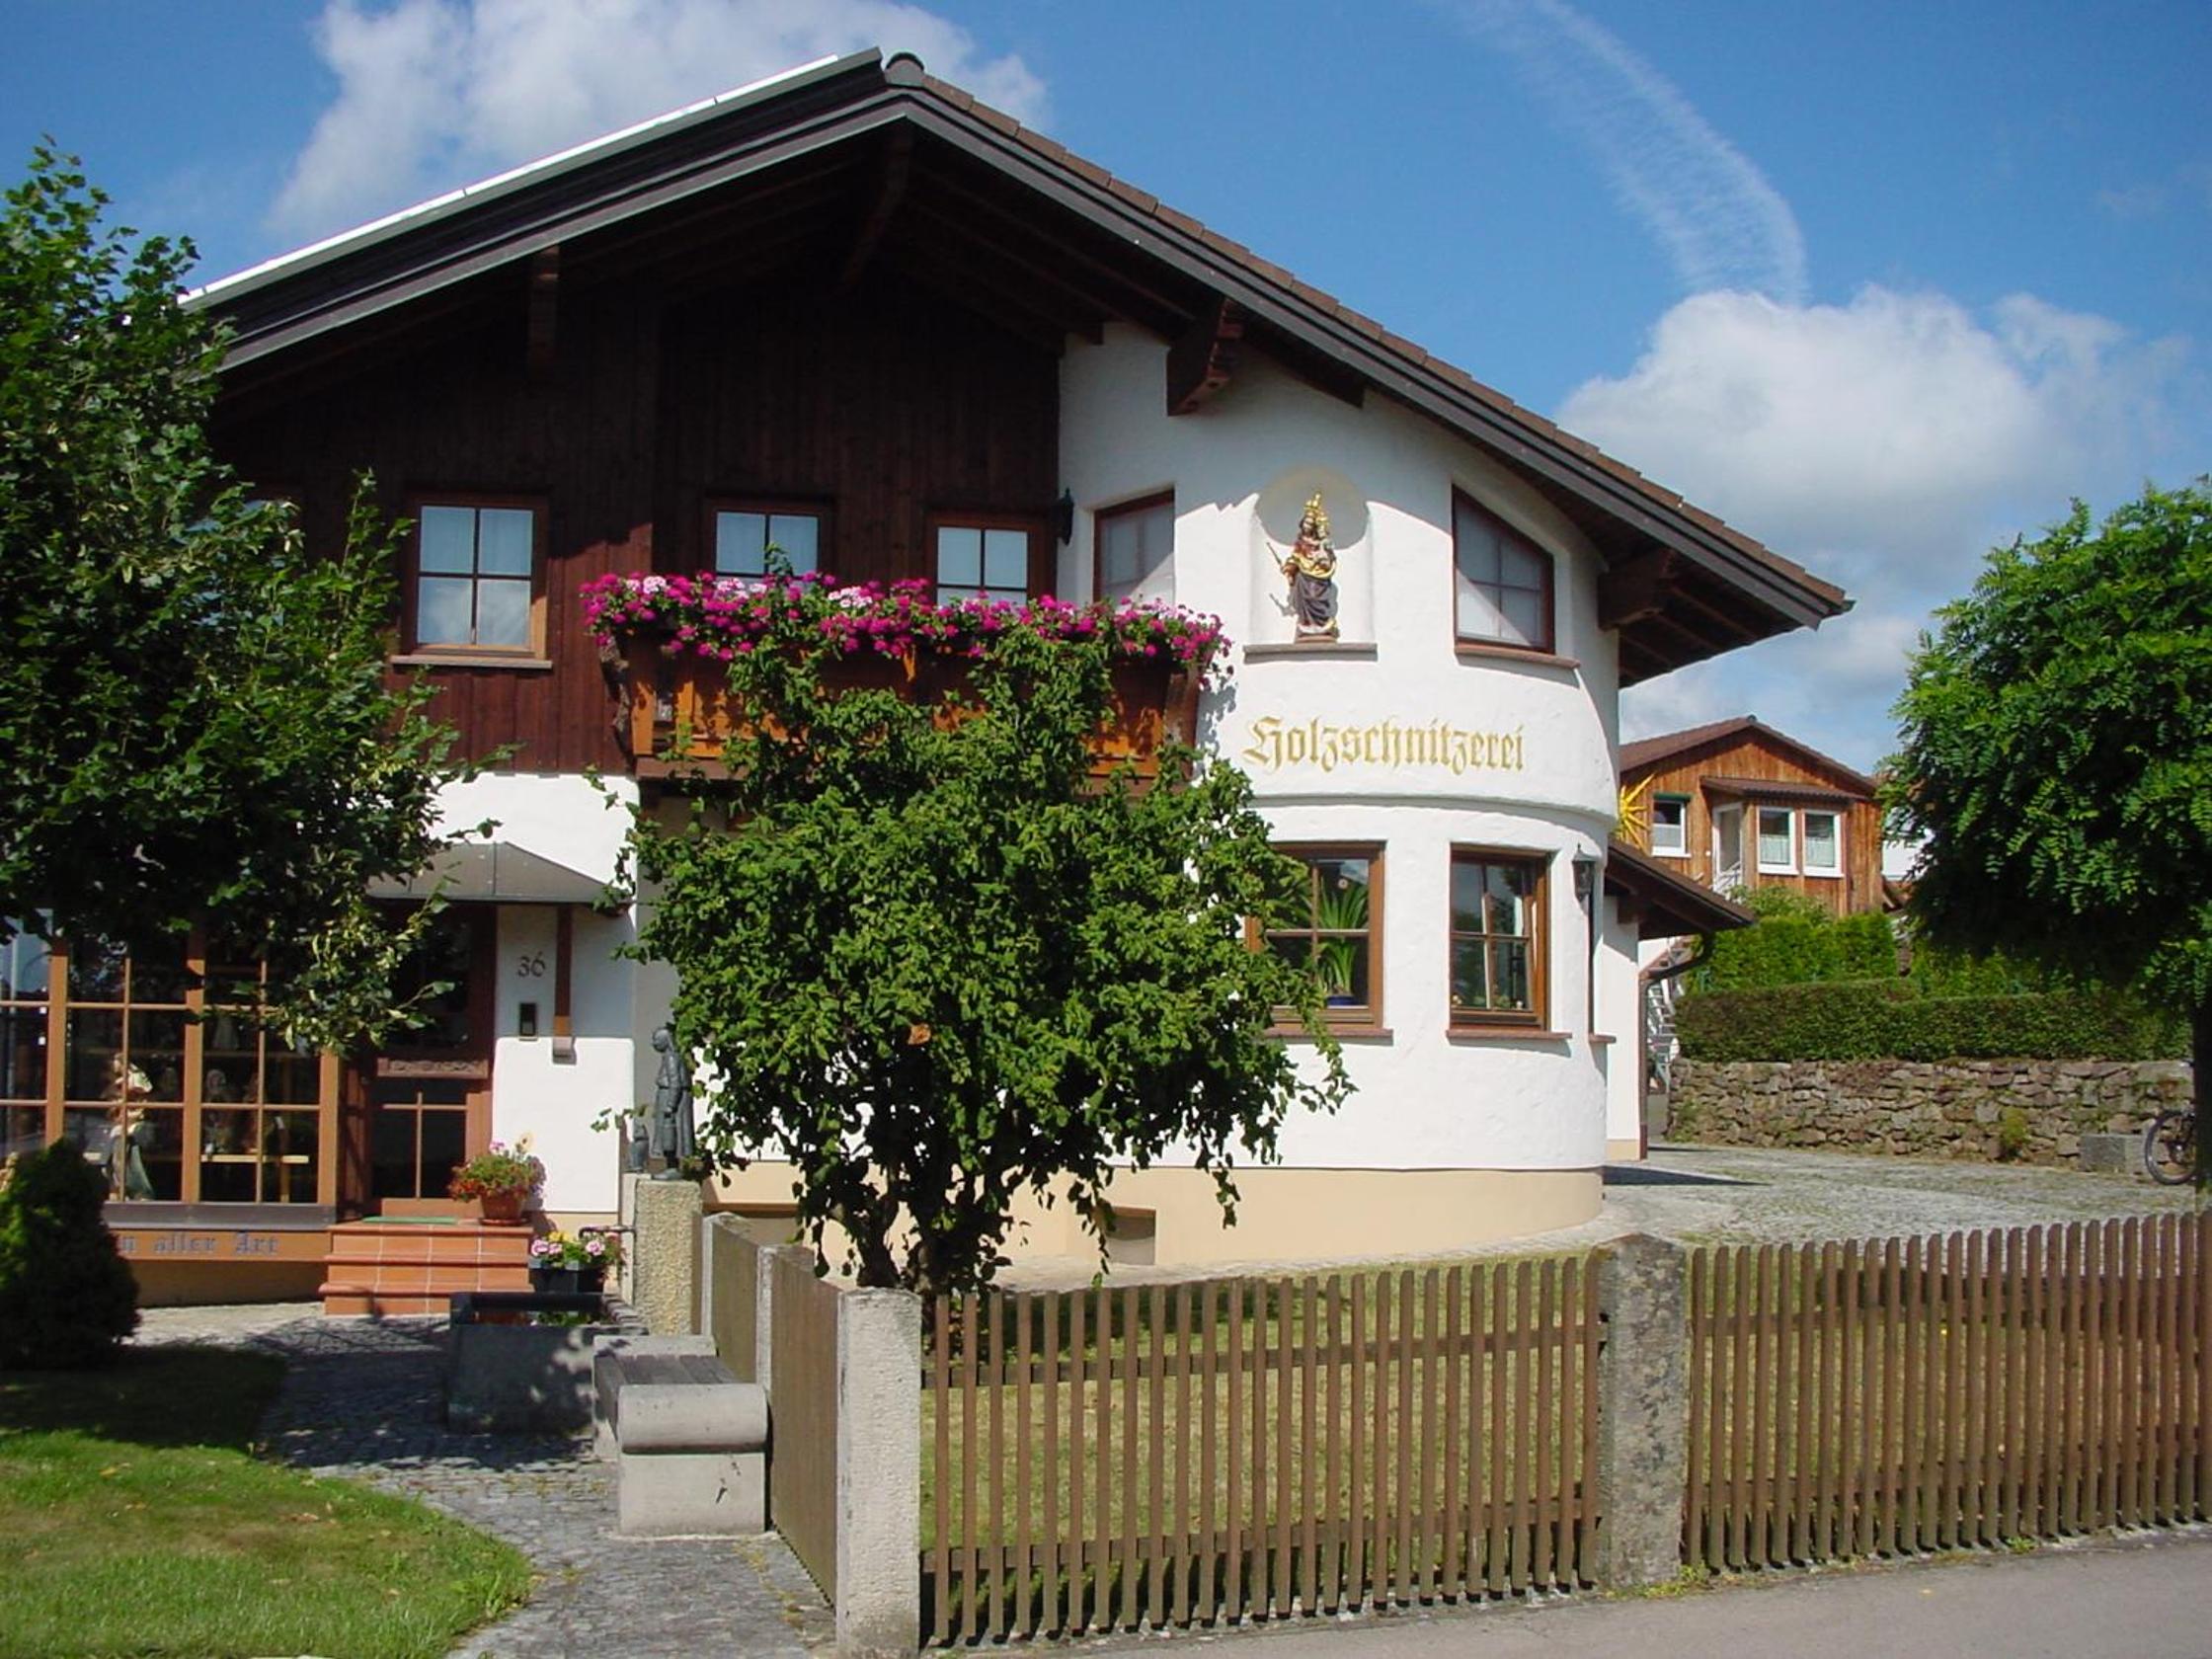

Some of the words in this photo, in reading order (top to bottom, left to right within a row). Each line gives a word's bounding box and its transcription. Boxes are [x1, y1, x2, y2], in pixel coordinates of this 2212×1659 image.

[1241, 714, 1524, 775] Holzschnitzerei
[517, 951, 546, 978] 36
[154, 1234, 216, 1253] aller
[235, 1231, 279, 1254] Art
